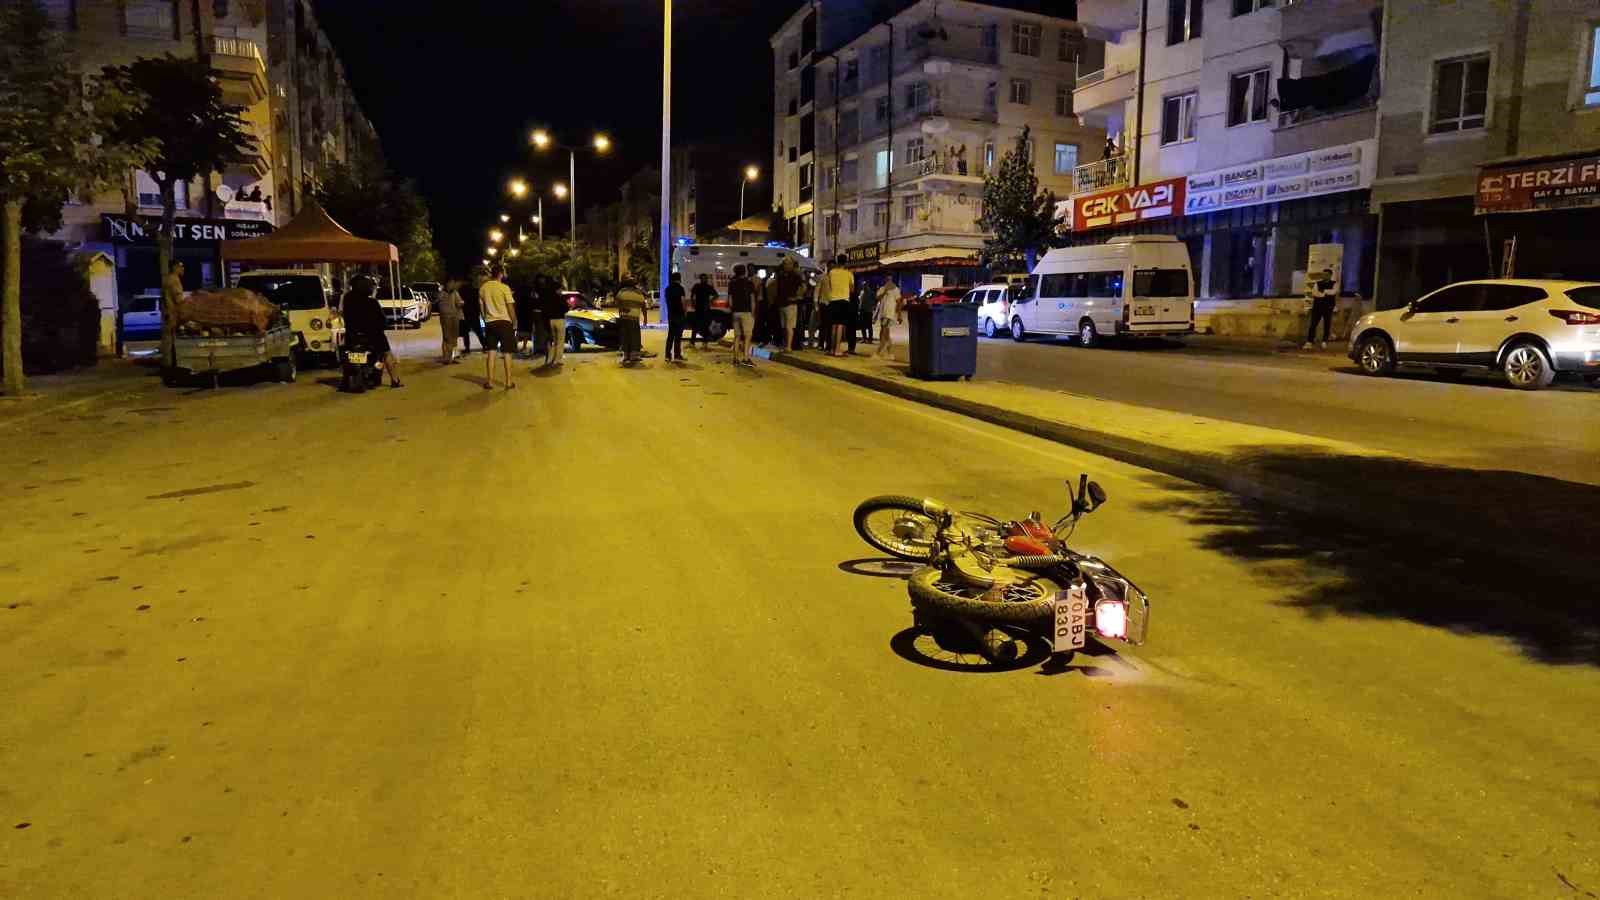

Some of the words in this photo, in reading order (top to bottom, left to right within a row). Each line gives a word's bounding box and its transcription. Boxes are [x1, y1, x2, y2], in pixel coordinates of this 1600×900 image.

[1506, 163, 1575, 189] TERZİ
[1082, 195, 1119, 217] CRK
[1125, 184, 1174, 209] YAPI
[191, 224, 226, 241] ŞEN
[1056, 604, 1069, 637] 830
